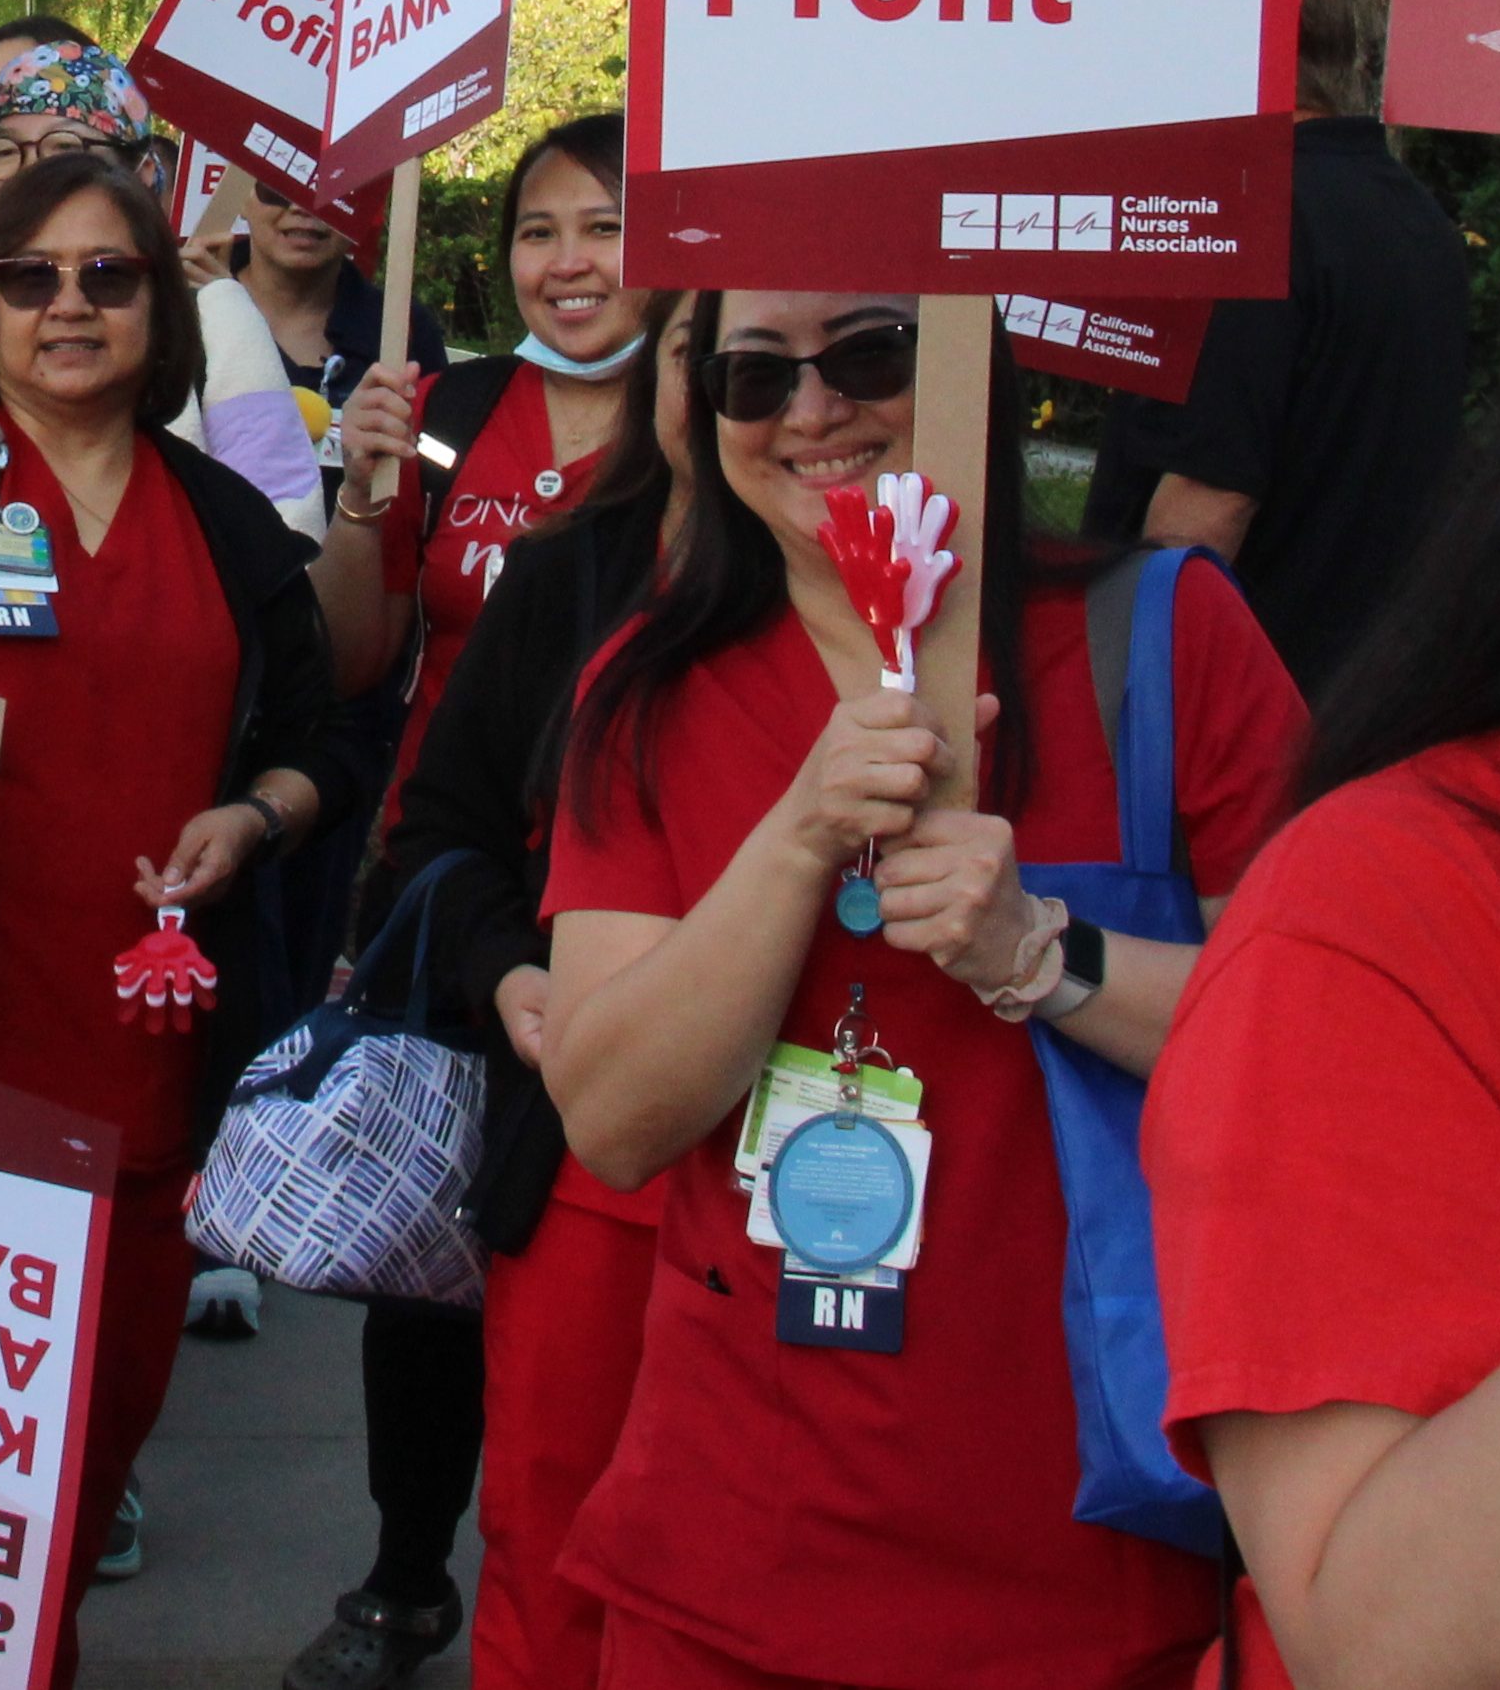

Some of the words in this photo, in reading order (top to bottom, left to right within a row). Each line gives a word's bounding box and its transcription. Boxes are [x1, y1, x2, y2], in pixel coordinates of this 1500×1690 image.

[1120, 196, 1219, 216] California
[1120, 216, 1190, 235] Nurses
[1119, 236, 1238, 255] Association
[1085, 325, 1132, 347] Nurses
[1089, 312, 1155, 339] California
[1081, 338, 1161, 368] Association
[812, 1286, 866, 1331] RN
